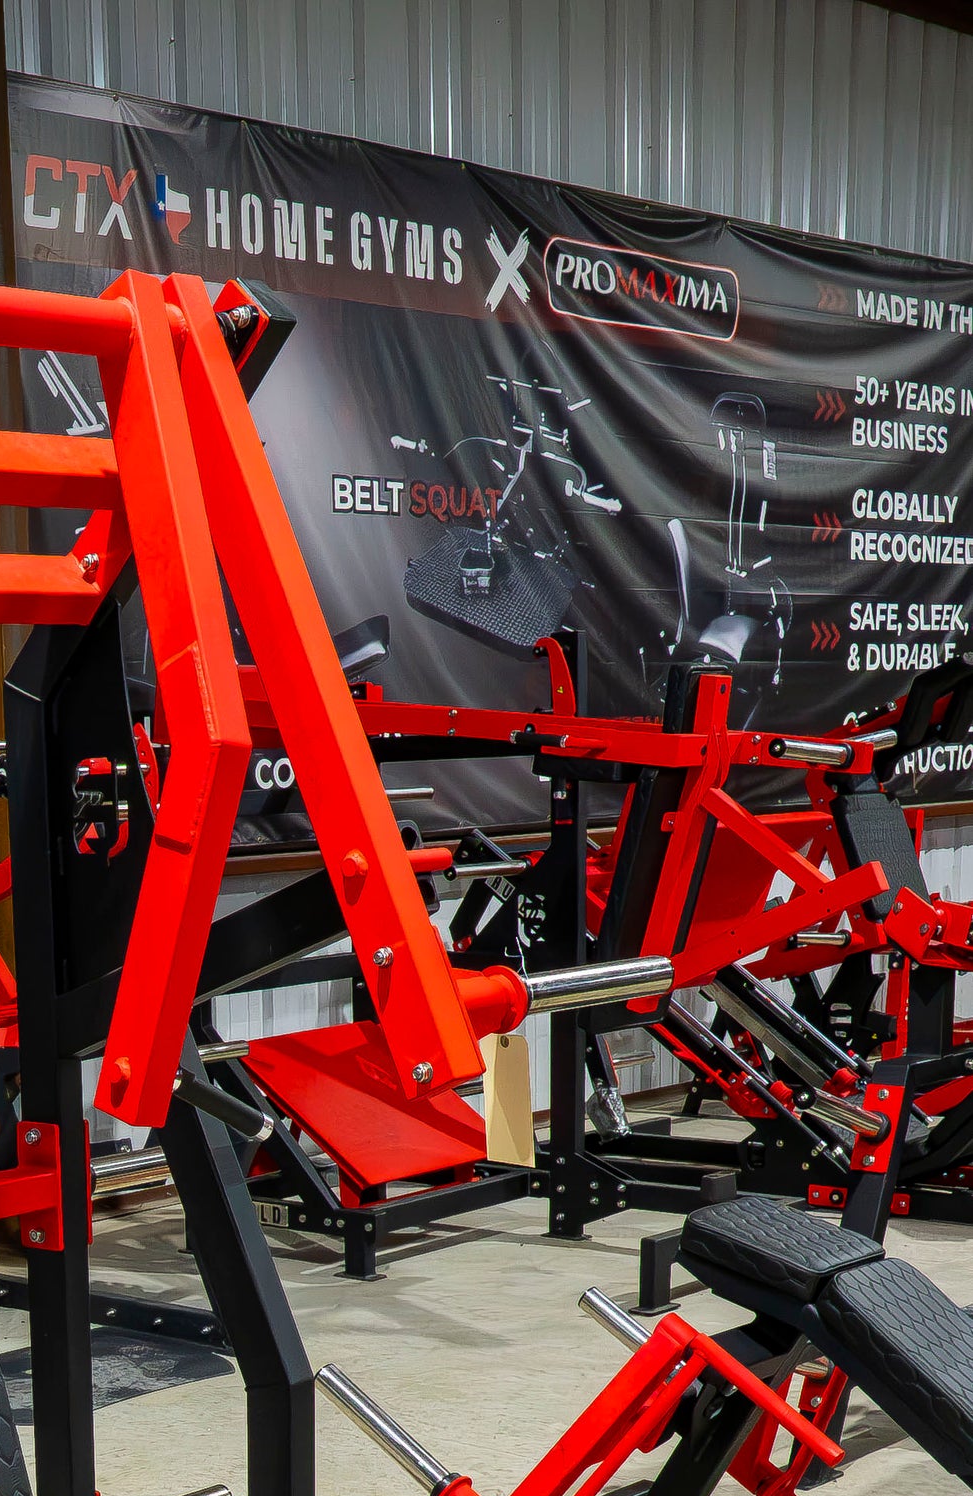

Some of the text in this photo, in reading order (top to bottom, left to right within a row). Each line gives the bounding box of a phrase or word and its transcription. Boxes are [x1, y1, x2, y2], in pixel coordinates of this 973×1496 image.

[24, 154, 138, 240] CTX
[205, 187, 463, 285] HOME GYMS
[555, 253, 727, 313] PROMAXIMA
[856, 289, 918, 326] MADE
[923, 300, 944, 330] IN
[854, 375, 890, 406] 50+
[894, 380, 956, 415] YEARS
[852, 417, 948, 454] BUSINESS
[333, 477, 502, 522] BELT SQUAT
[852, 488, 959, 524] GLOBALLY
[849, 602, 969, 637] SAFE, SLEEK,
[847, 643, 861, 671] &
